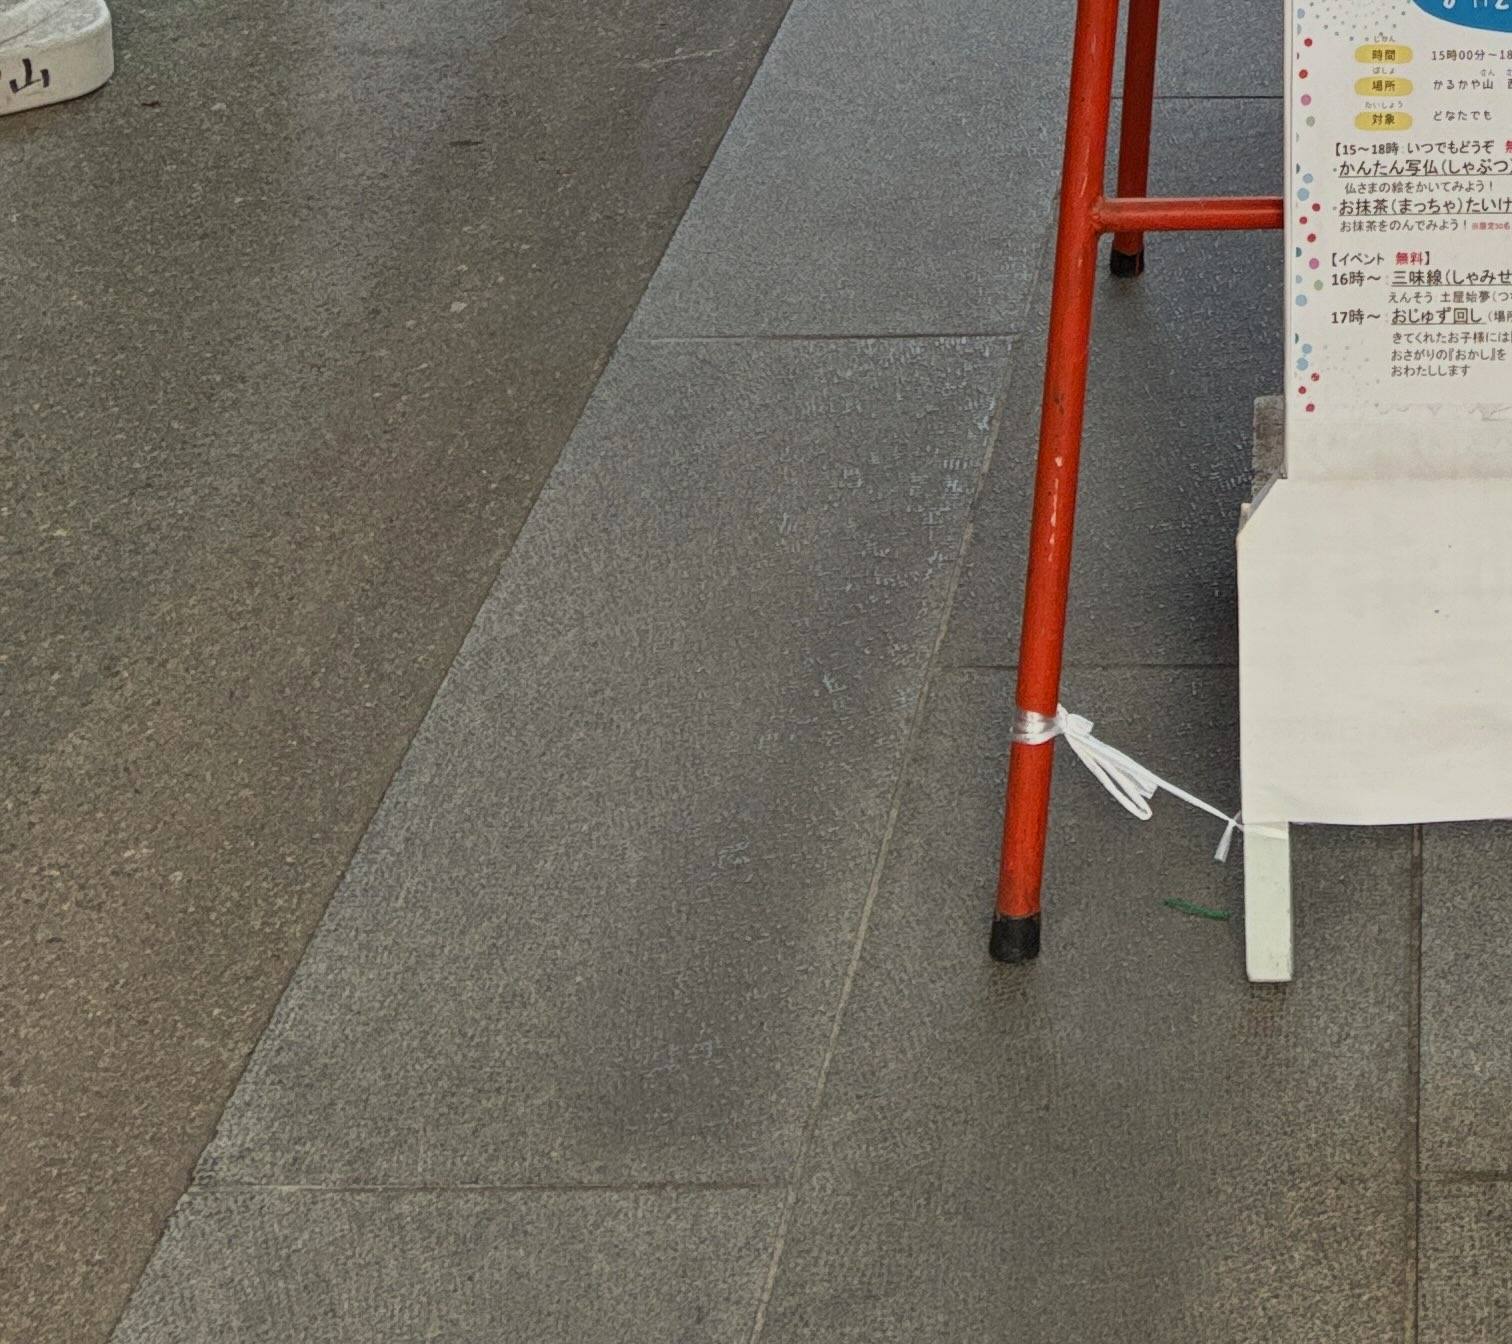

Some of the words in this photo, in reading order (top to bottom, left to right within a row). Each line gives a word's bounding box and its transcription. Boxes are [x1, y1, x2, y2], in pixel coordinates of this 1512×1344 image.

[1371, 49, 1397, 62] 時間
[1371, 79, 1397, 92] 場所
[1432, 78, 1495, 91] かるかや山
[1371, 113, 1396, 126] 対象
[1432, 109, 1493, 122] どなたでも
